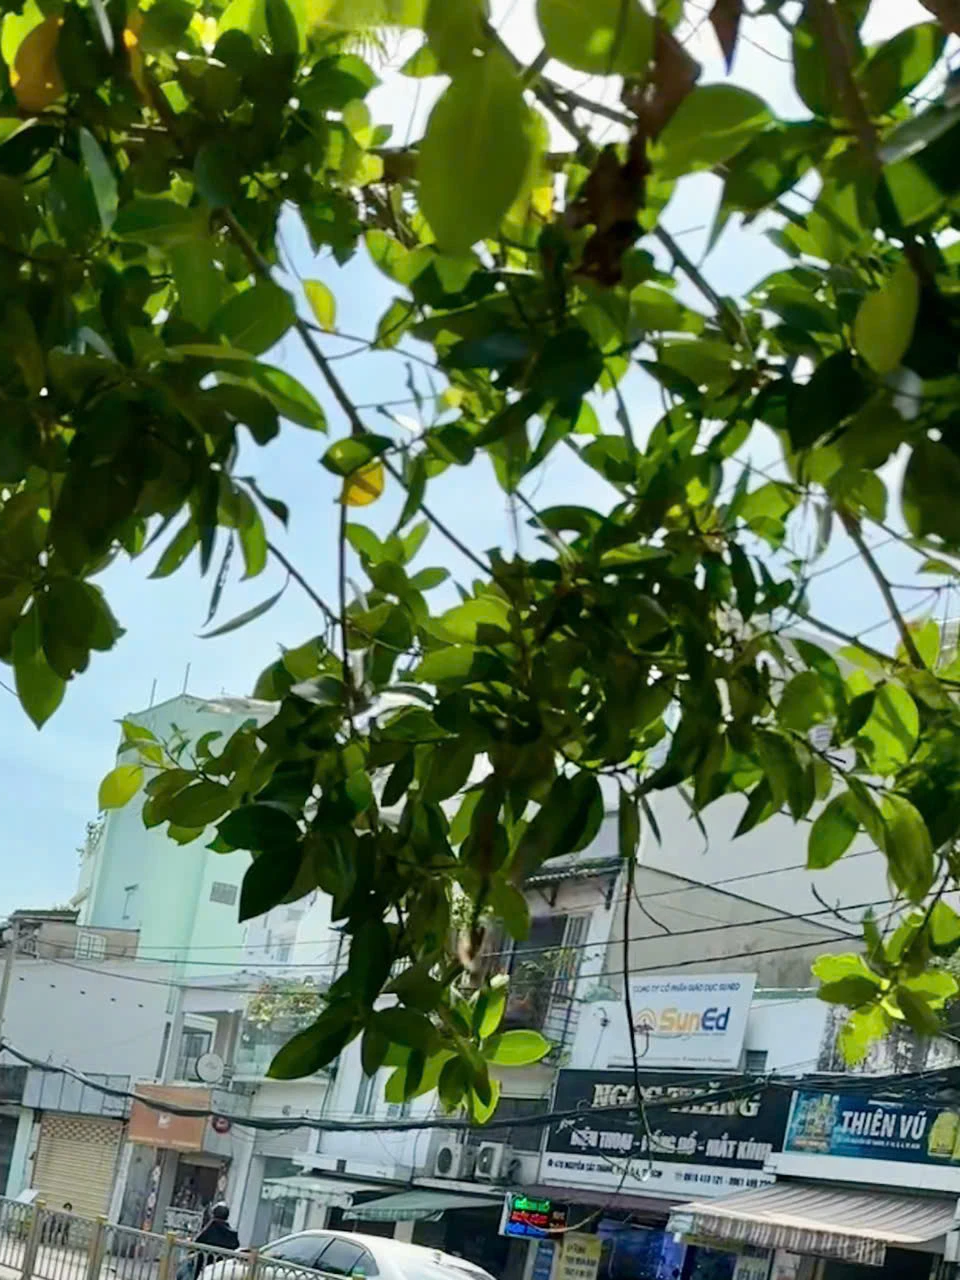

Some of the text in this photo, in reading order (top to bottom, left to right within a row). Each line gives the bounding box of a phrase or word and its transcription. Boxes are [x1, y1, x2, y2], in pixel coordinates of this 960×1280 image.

[660, 1006, 731, 1032] SunEd
[839, 1108, 927, 1141] THIÊN VŨ
